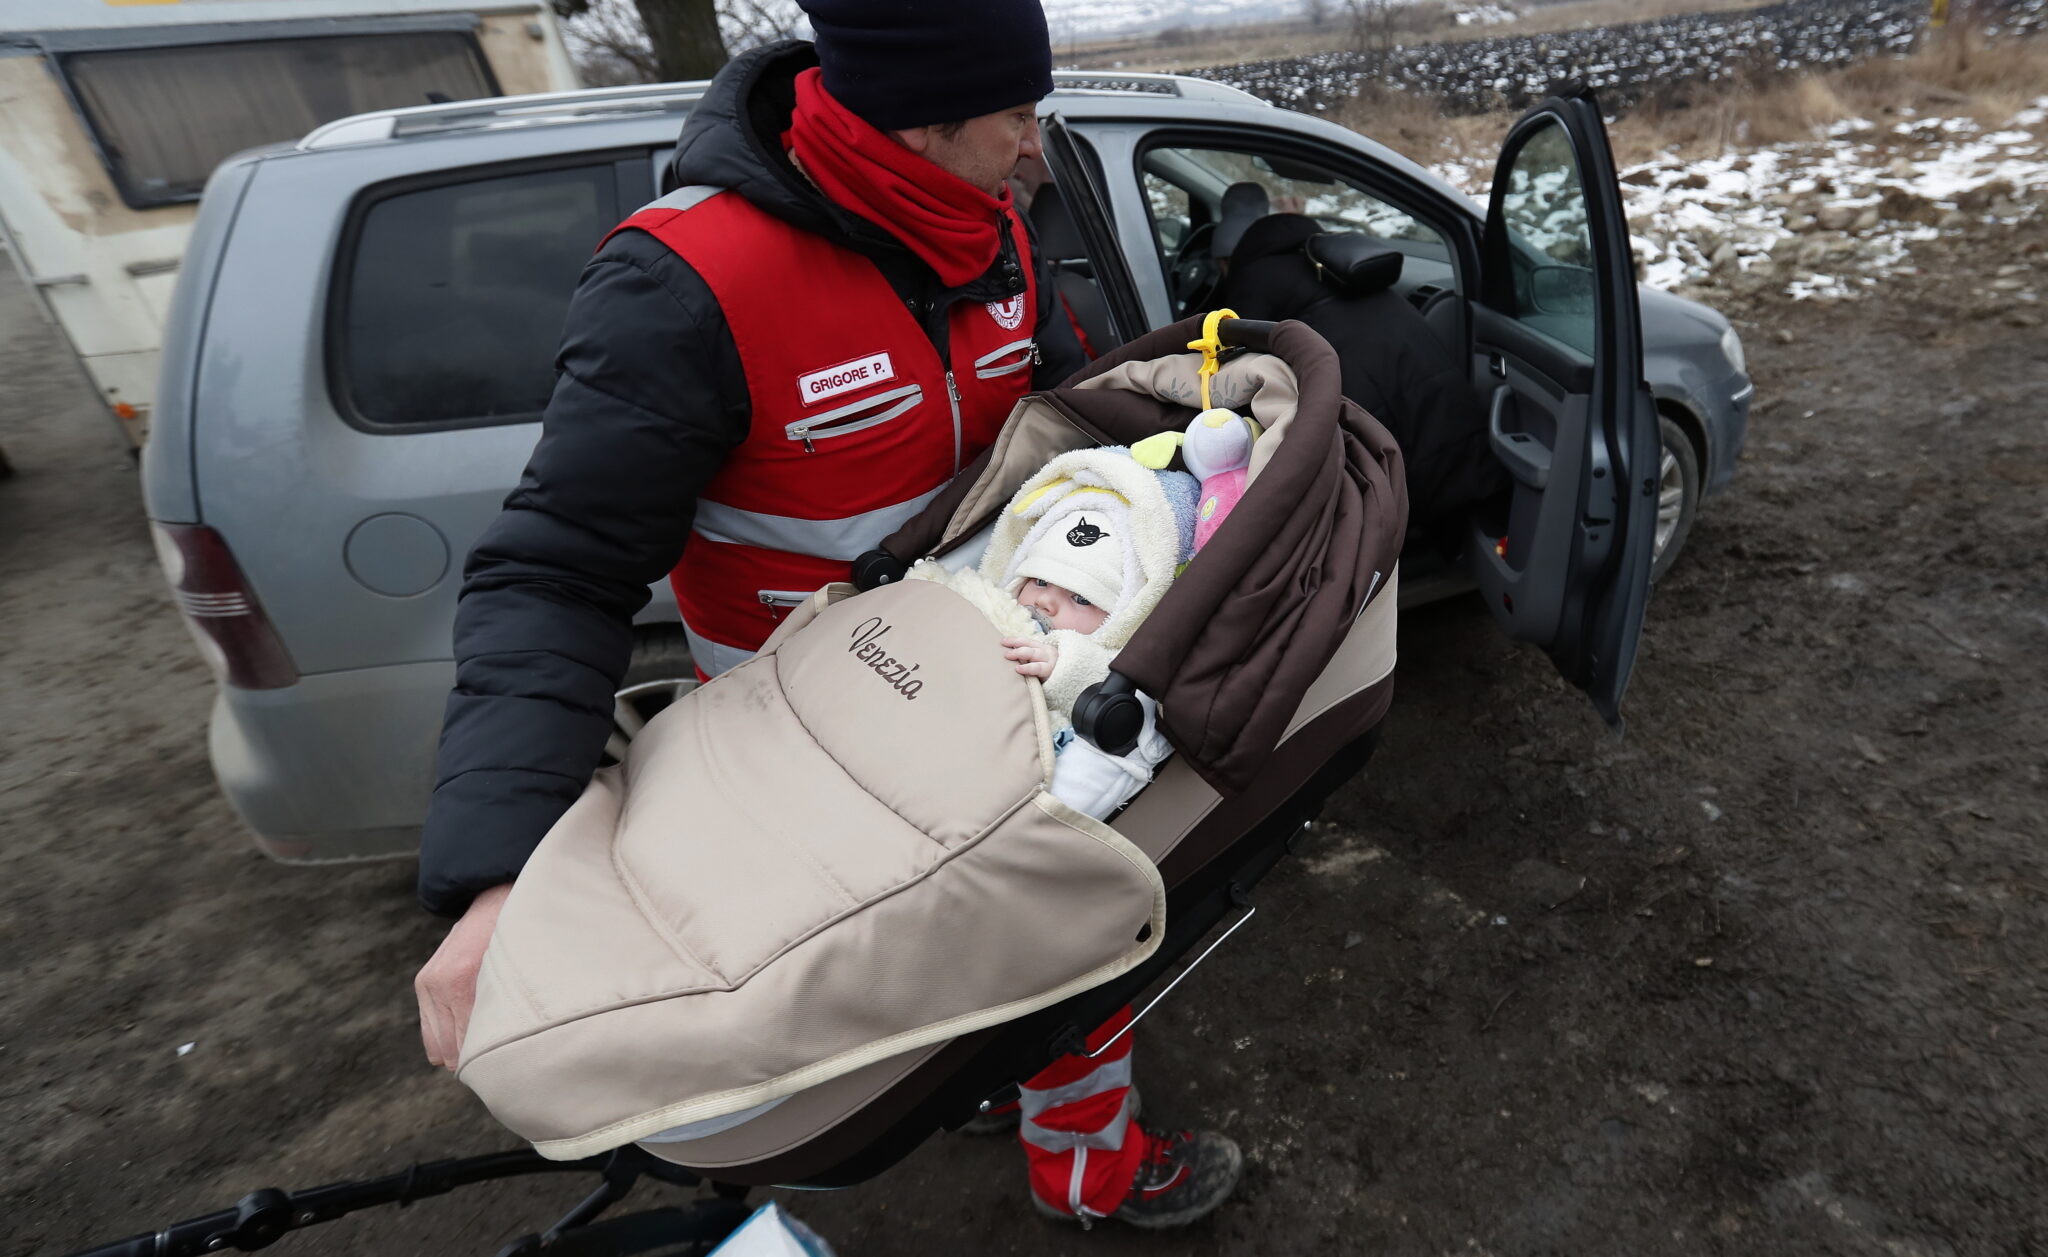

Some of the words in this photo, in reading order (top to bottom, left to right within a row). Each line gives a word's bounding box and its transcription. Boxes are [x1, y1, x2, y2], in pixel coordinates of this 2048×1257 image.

[810, 366, 869, 394] GRIGORE
[873, 362, 885, 374] P.
[848, 617, 923, 700] Venezia
